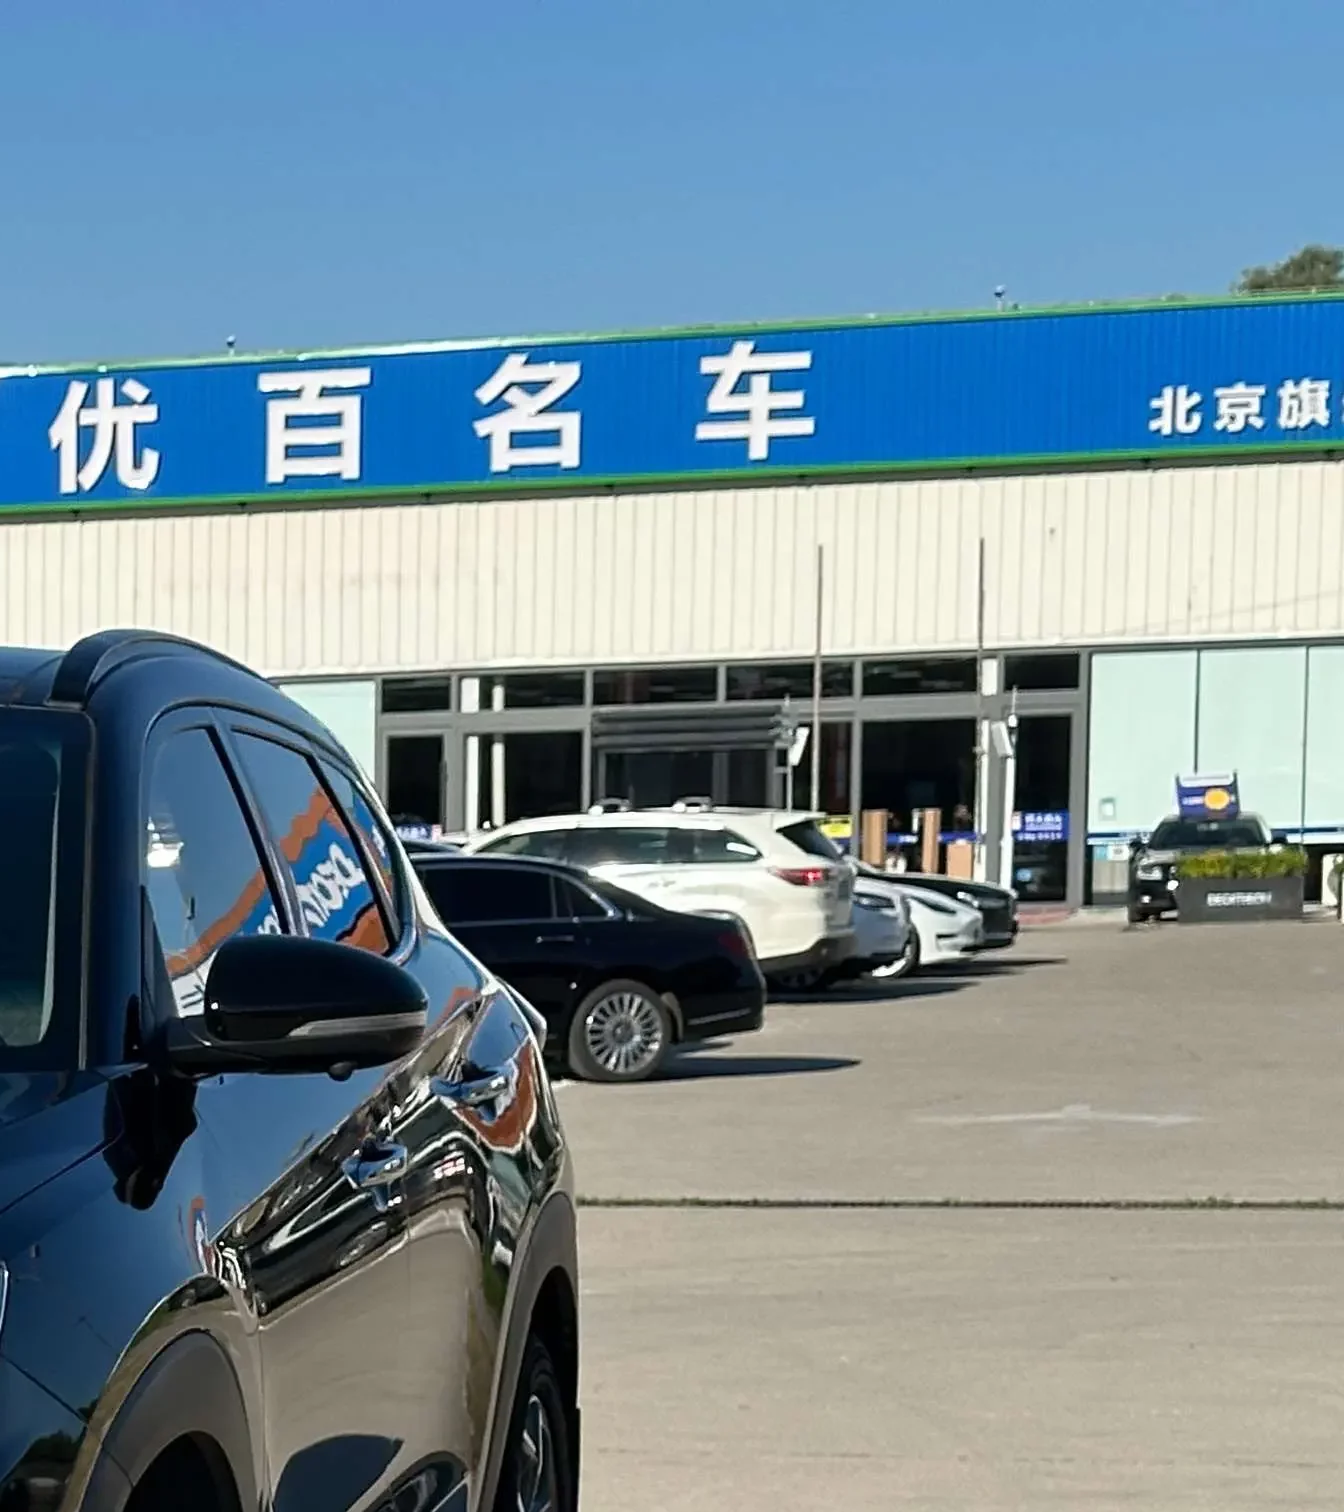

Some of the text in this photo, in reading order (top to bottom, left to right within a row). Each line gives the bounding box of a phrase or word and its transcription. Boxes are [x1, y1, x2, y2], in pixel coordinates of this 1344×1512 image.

[47, 340, 816, 495] 优百名车
[1148, 376, 1344, 436] 北京旗
